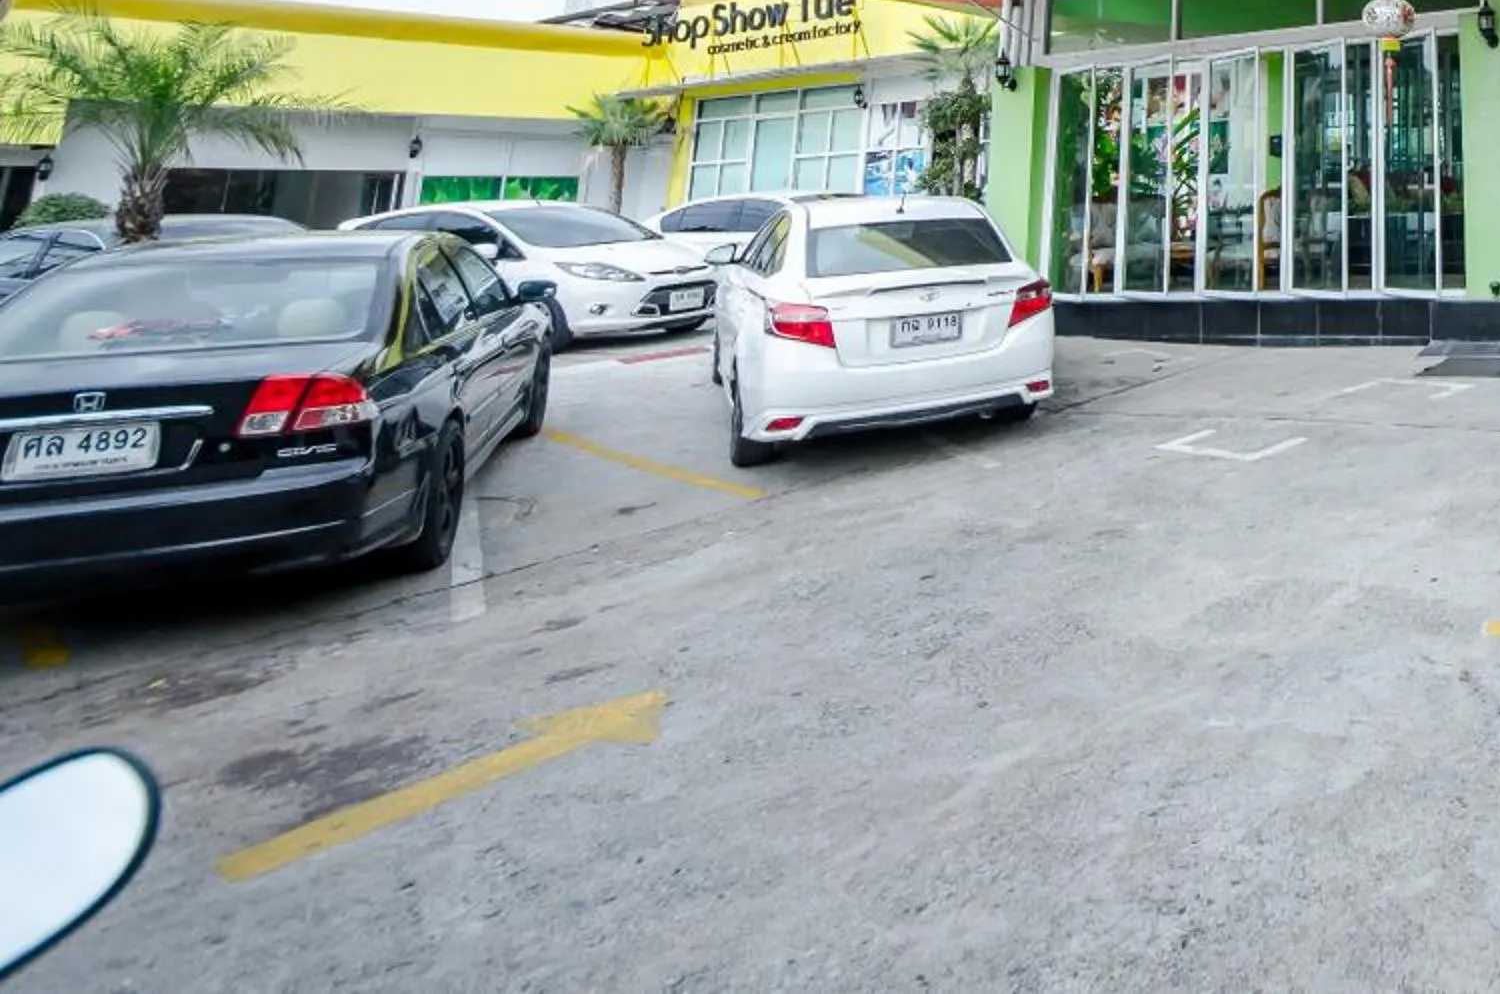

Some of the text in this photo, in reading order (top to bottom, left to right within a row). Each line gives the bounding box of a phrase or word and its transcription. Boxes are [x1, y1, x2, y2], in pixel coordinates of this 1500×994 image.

[711, 1, 788, 36] Show
[707, 20, 861, 55] cosmetic & cream factory
[77, 427, 148, 453] 4892
